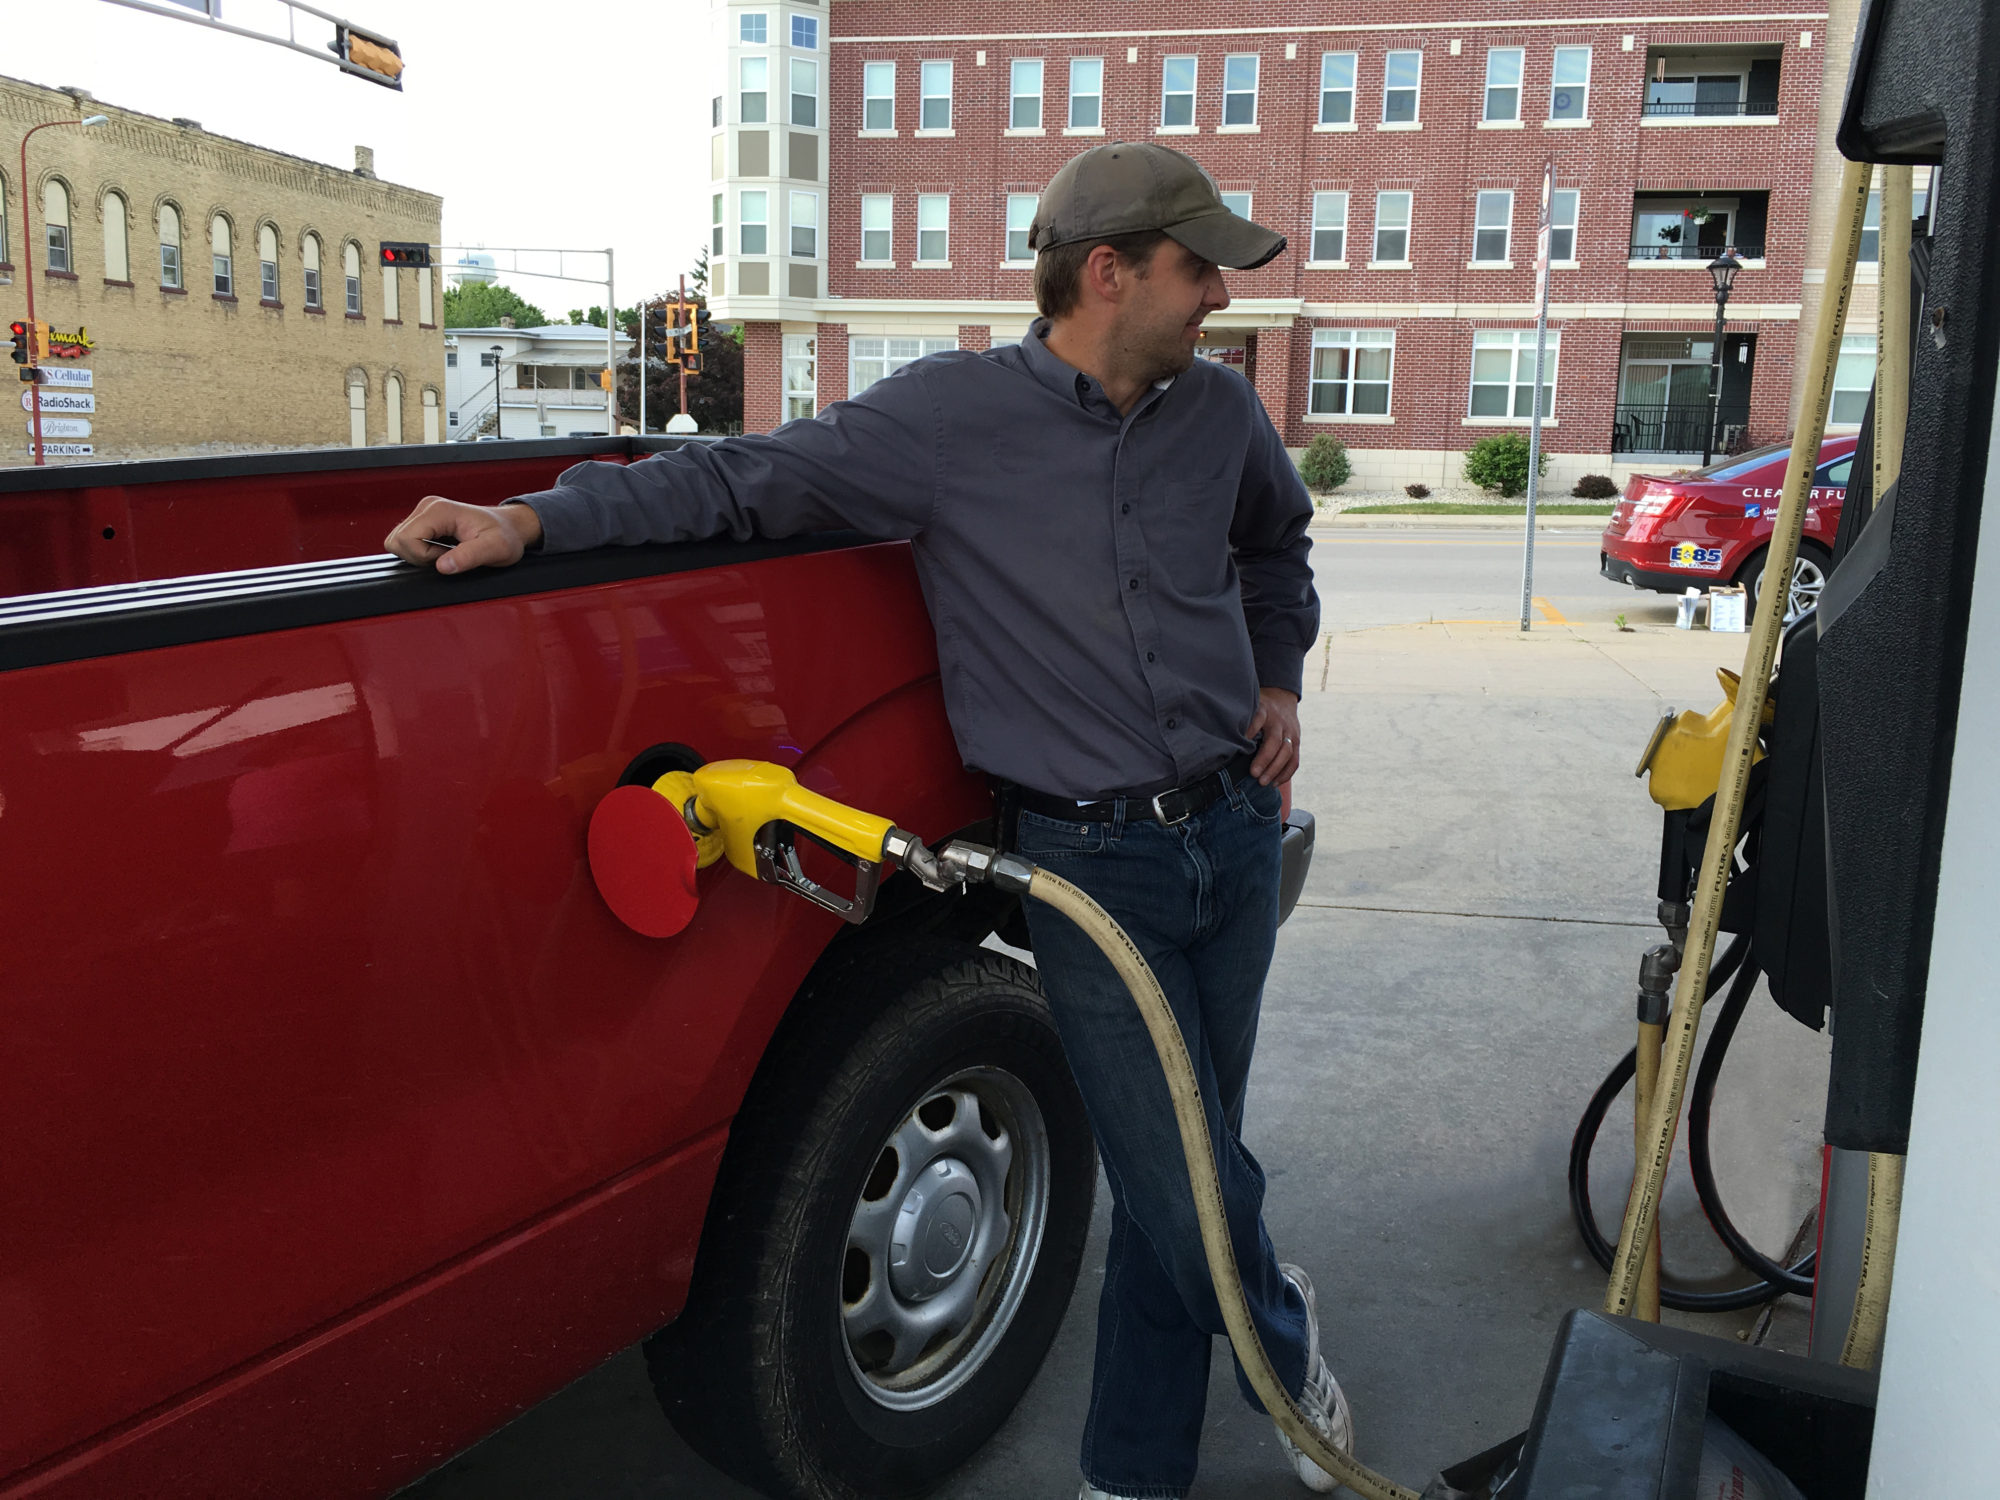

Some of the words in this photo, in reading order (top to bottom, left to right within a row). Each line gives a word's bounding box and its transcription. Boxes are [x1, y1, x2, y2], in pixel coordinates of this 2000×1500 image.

[1848, 244, 1856, 257] HOSE
[1843, 258, 1854, 282] GASOLINE
[1833, 285, 1847, 336] FUTURA
[55, 369, 91, 381] Cellular
[1816, 398, 1825, 415] LISTED
[42, 445, 80, 454] PARKING
[1742, 488, 1819, 500] CLEAR
[1796, 499, 1804, 513] MADE
[1790, 527, 1798, 540] HOSE
[1785, 540, 1796, 564] GASOLINE
[1773, 567, 1789, 617] FUTURA
[1042, 873, 1057, 884] MADE
[1698, 952, 1706, 969] LISTED
[1714, 843, 1730, 892] FUTURA
[1725, 817, 1735, 840] GASOLINE
[1730, 803, 1738, 816] HOSE
[1735, 776, 1743, 789] MADE
[1072, 890, 1085, 901] HOSE
[1085, 900, 1107, 920] GASOLINE
[1109, 921, 1144, 967] FUTURA
[1636, 1227, 1645, 1244] LISTED
[1655, 1117, 1671, 1167] FUTURA
[1666, 1091, 1677, 1114] GASOLINE
[1672, 1078, 1680, 1091] HOSE
[1214, 1175, 1225, 1219] FUTURA
[1860, 1237, 1871, 1288] FUTURA
